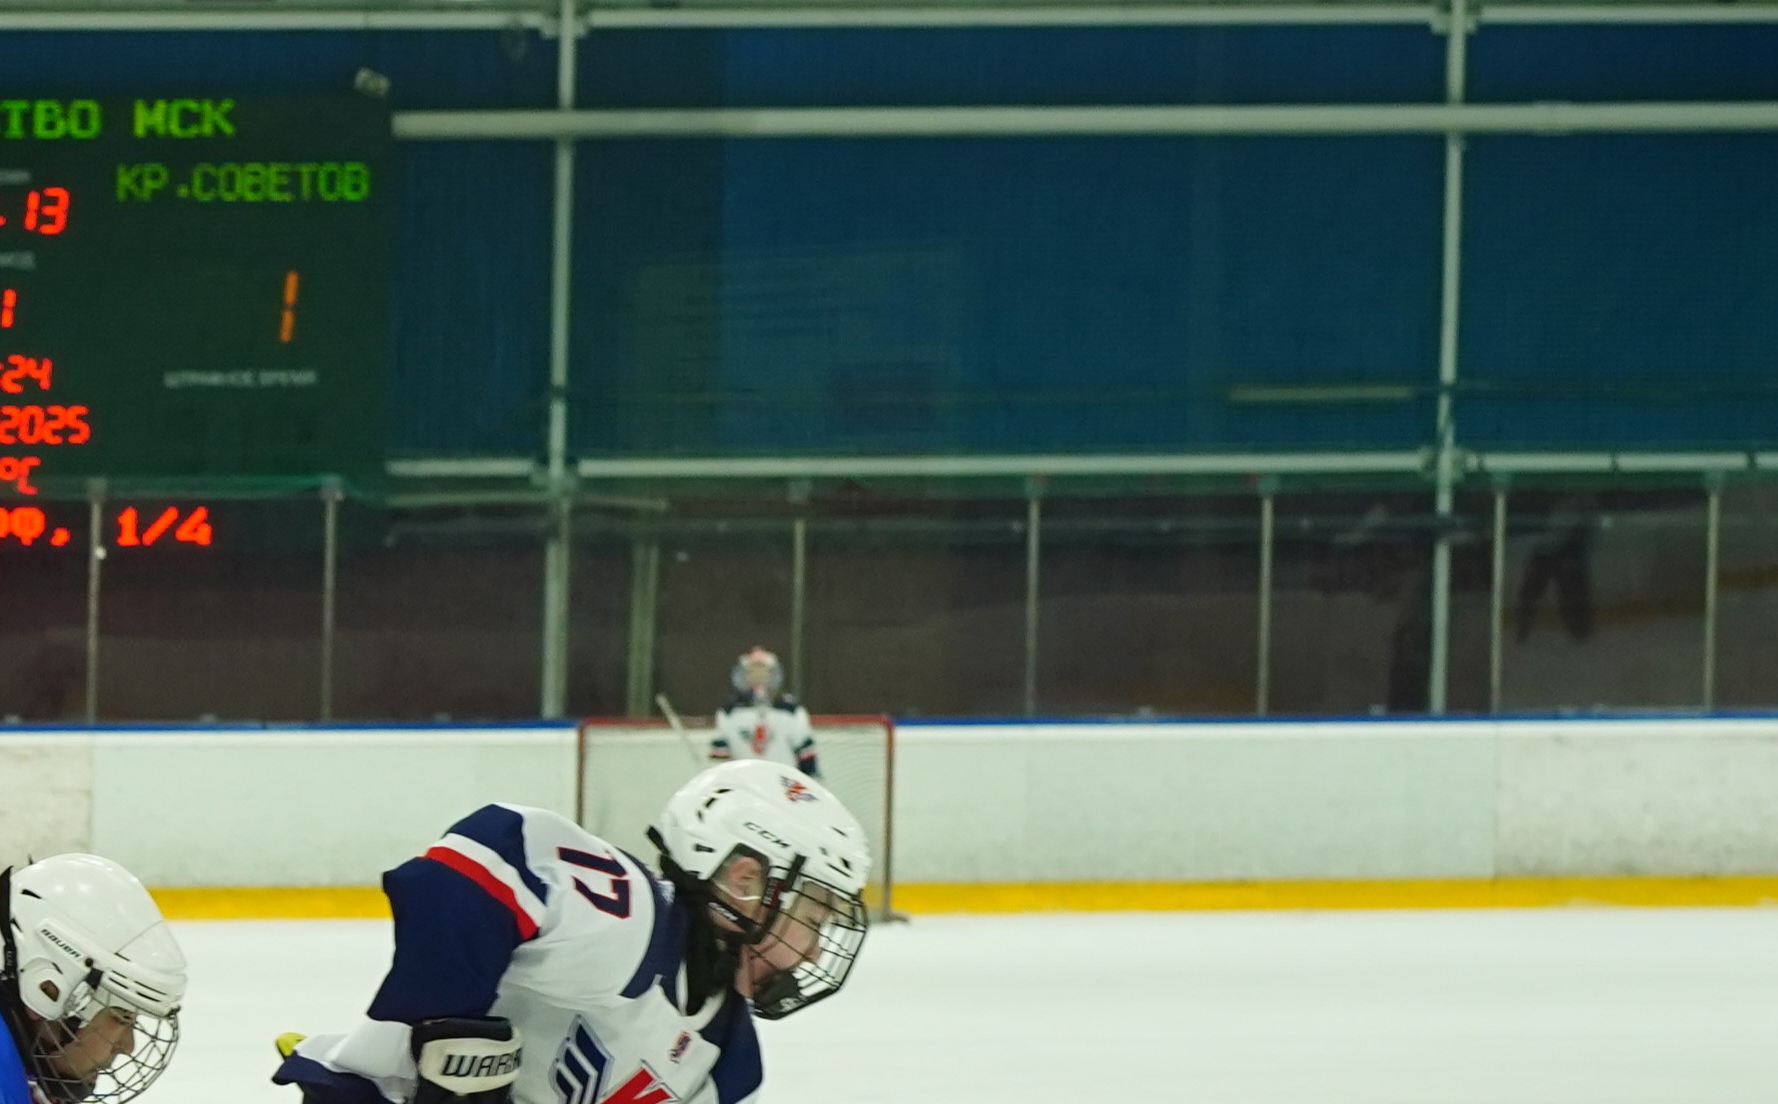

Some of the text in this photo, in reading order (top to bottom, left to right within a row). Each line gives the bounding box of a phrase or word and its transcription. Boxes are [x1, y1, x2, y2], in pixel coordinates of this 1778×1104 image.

[133, 99, 236, 137] МСК
[117, 162, 370, 202] КР.СОВЕТОВ
[0, 289, 17, 328] 1
[280, 270, 299, 342] 1
[117, 505, 213, 547] 1/4
[556, 846, 633, 919] 17
